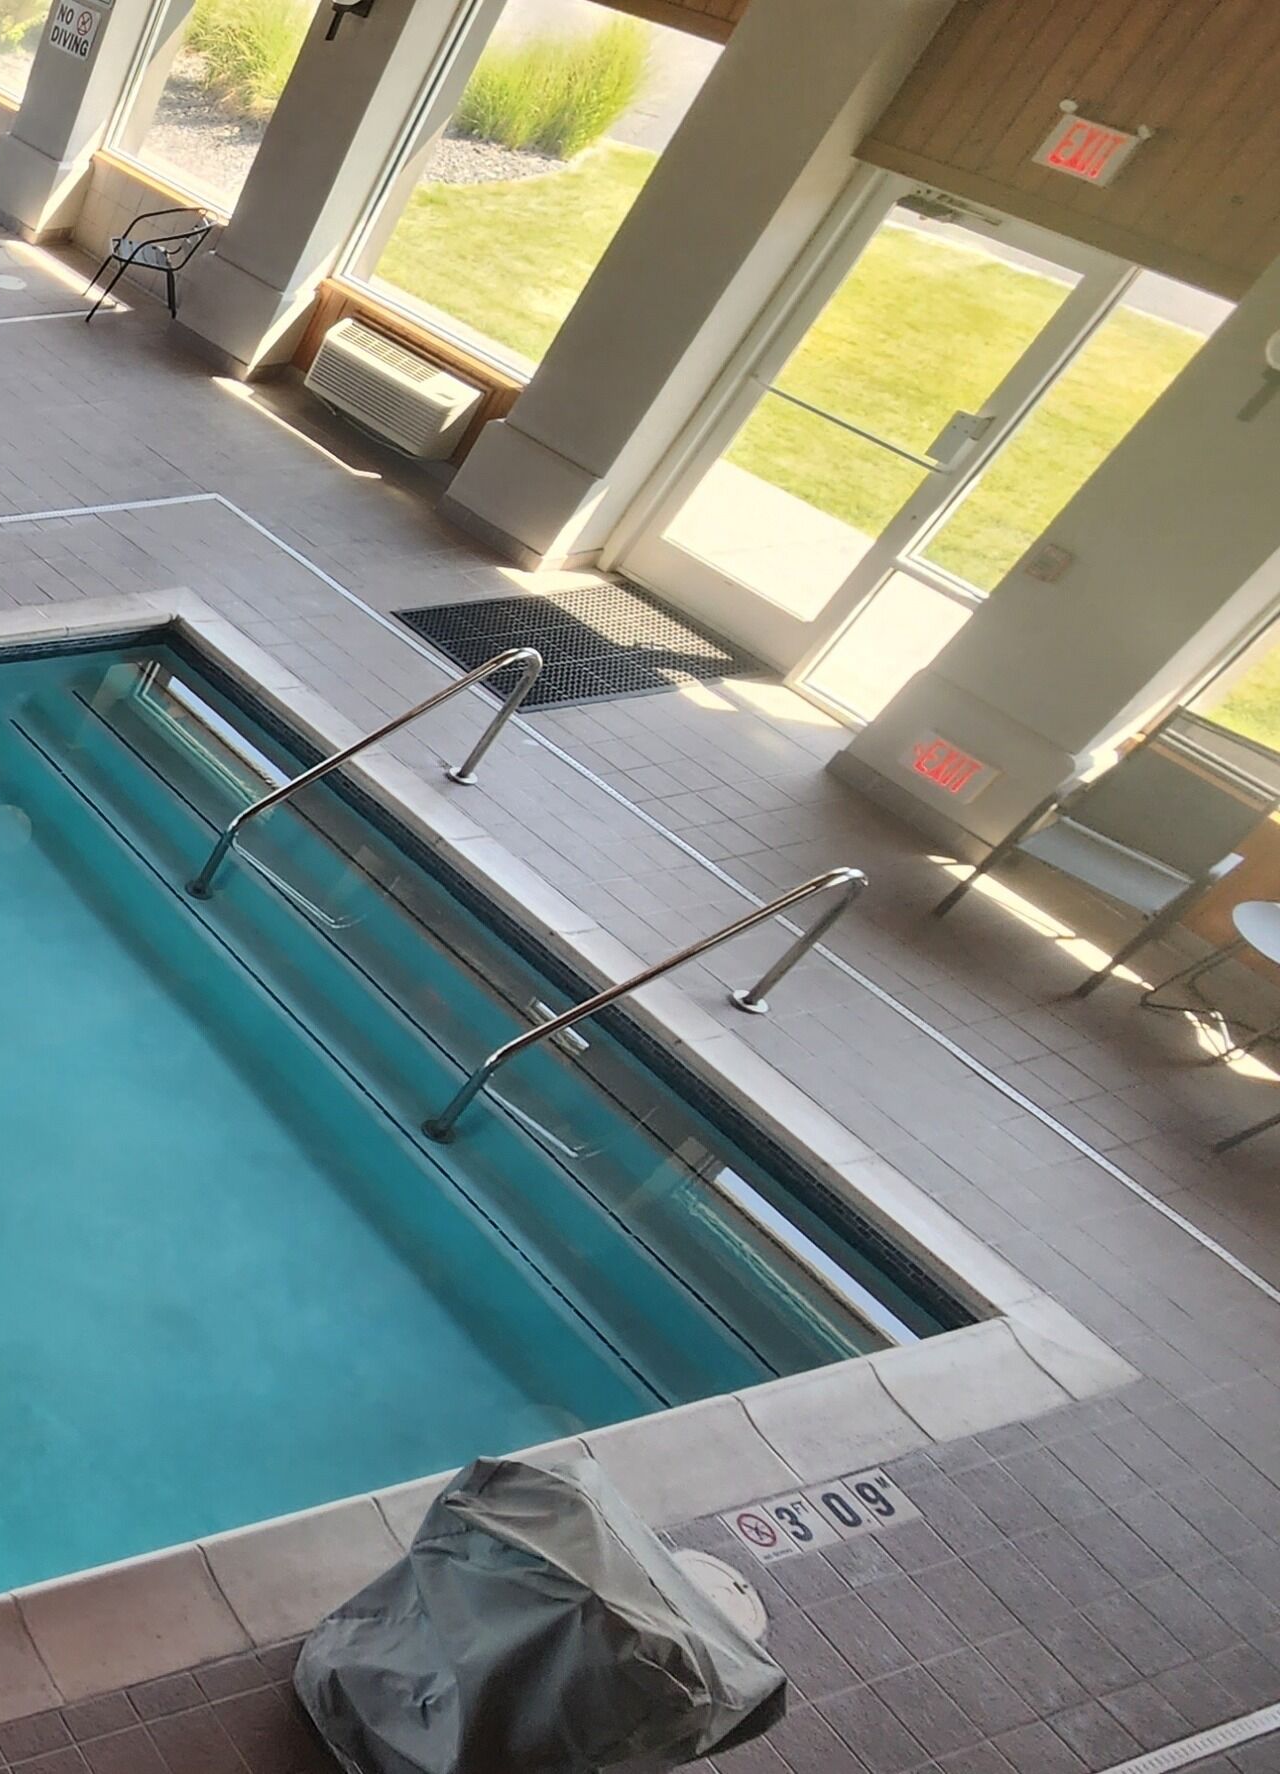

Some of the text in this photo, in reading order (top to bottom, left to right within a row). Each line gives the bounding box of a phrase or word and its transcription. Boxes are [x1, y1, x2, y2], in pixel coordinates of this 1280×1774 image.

[57, 4, 74, 25] NO
[51, 25, 89, 56] DIVING
[1049, 121, 1128, 178] EXIT
[913, 738, 983, 793] EXIT
